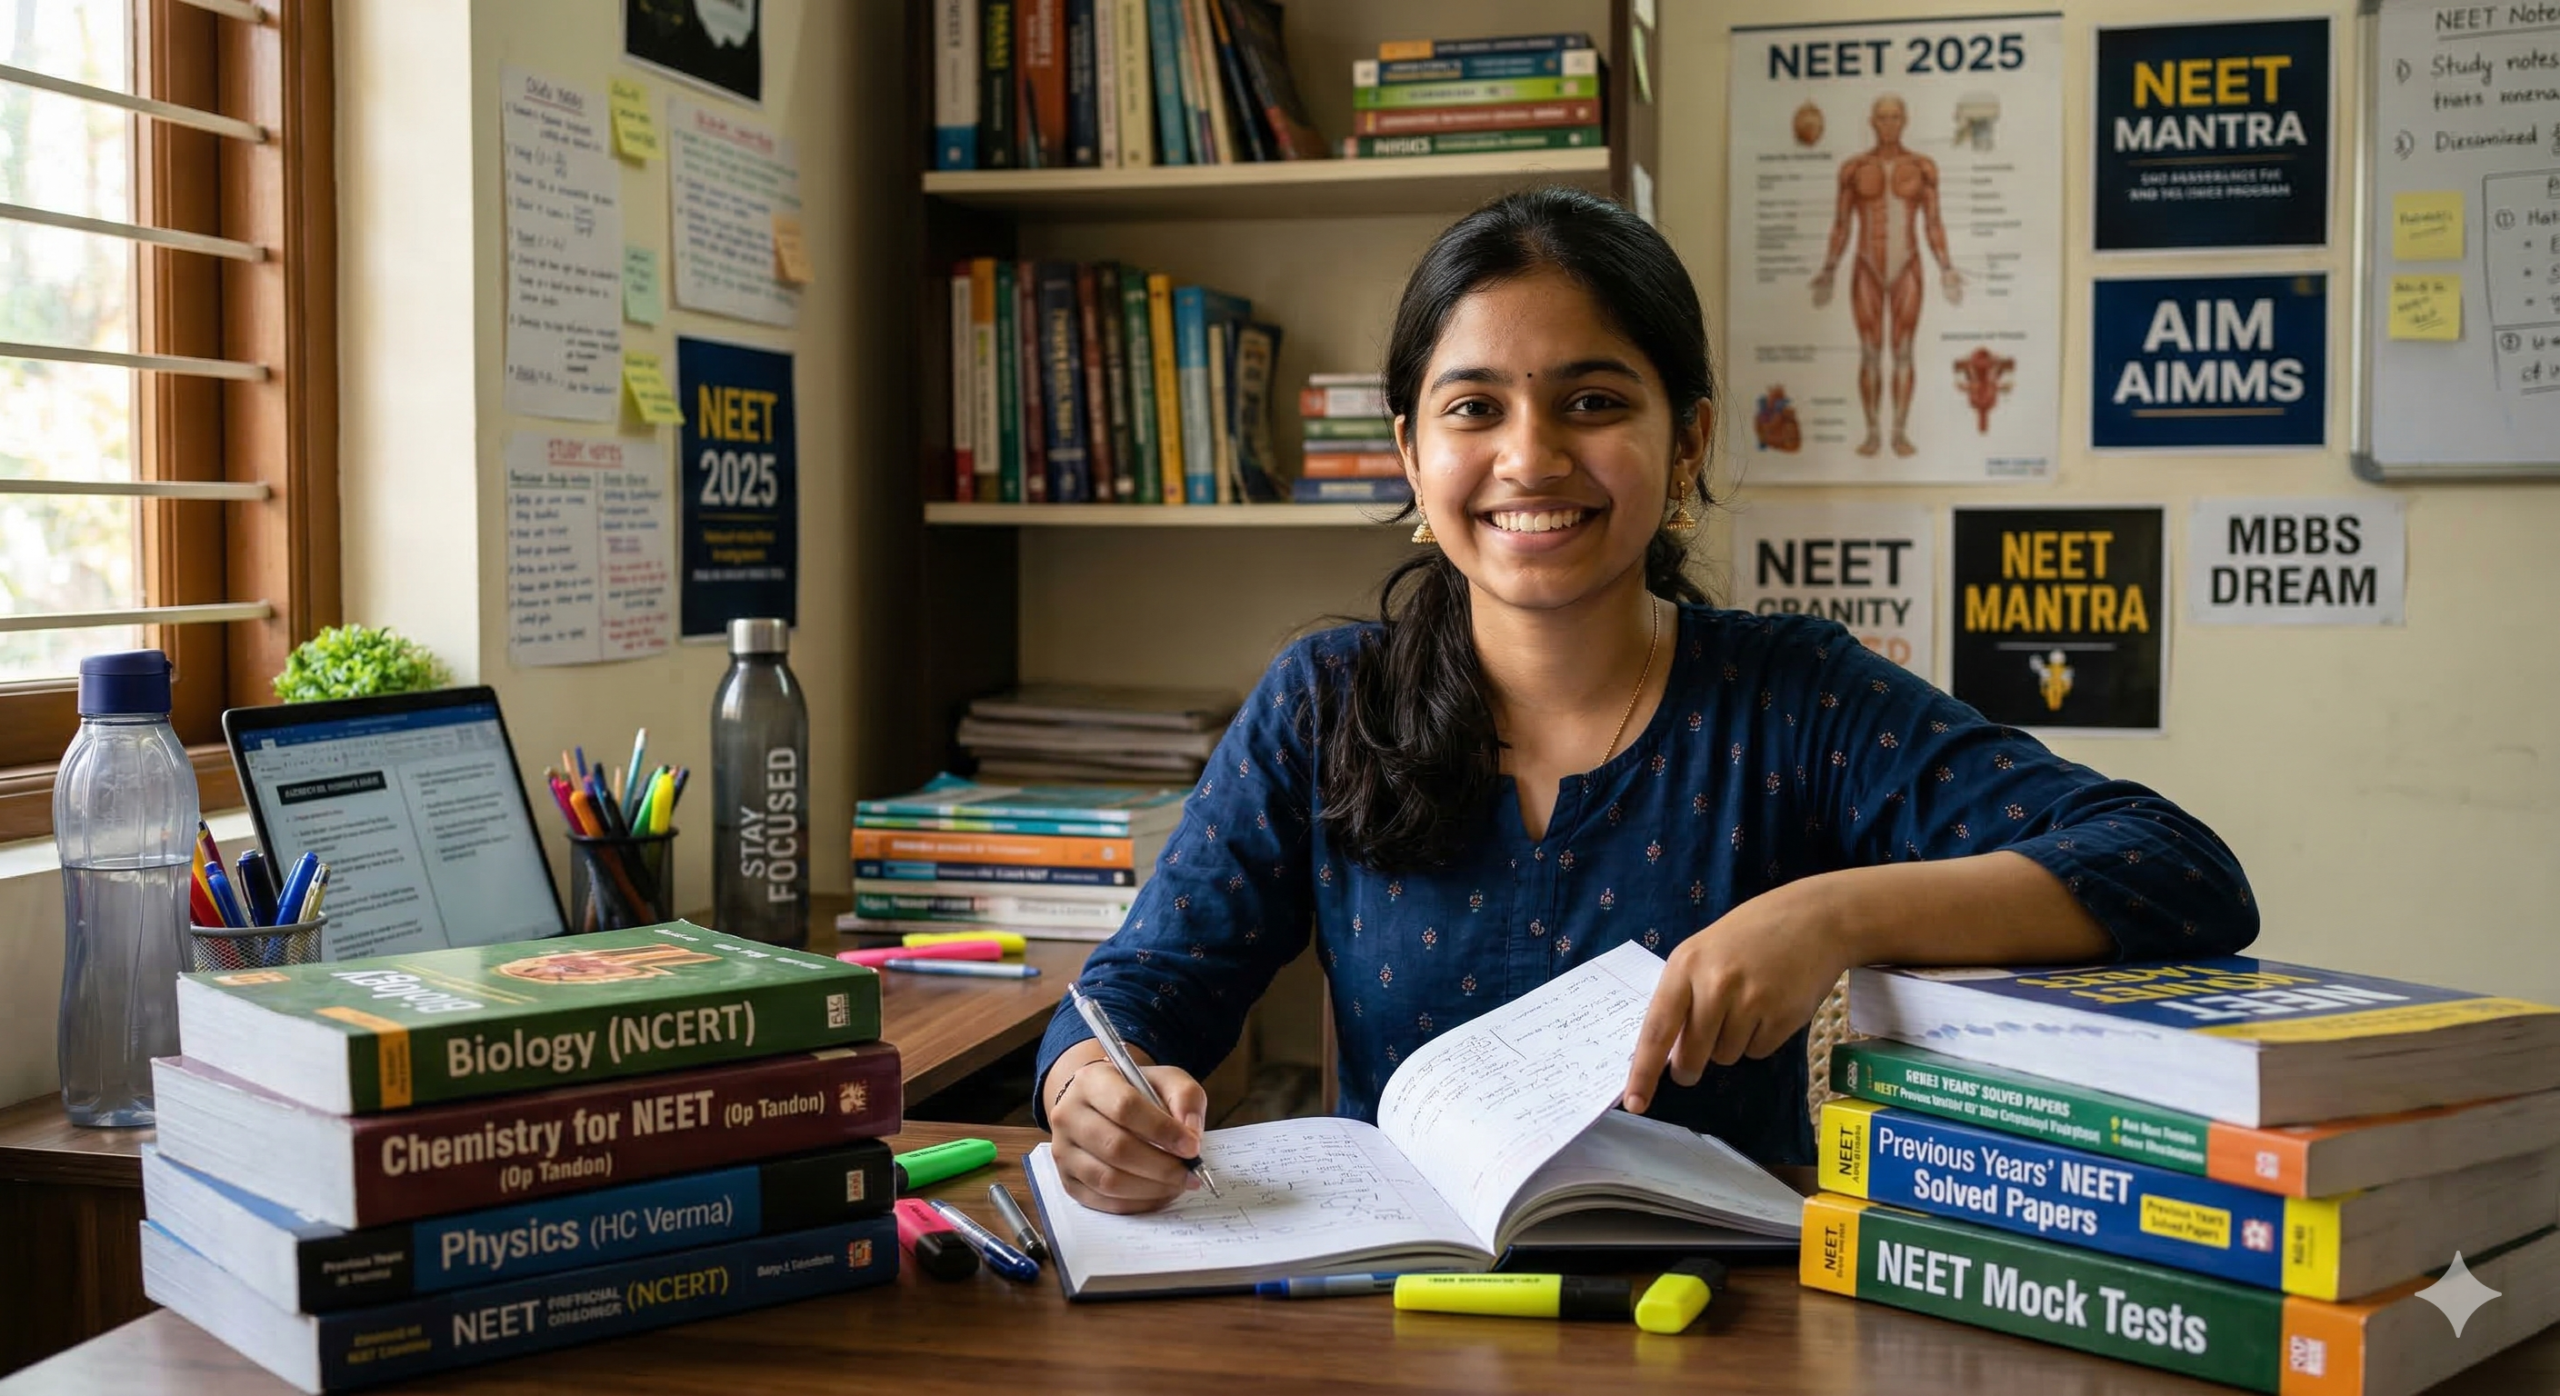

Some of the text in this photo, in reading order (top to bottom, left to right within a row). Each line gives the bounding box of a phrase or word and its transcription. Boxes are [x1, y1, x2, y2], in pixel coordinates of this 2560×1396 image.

[2435, 2, 2560, 31] NEET Note
[1768, 34, 2026, 80] NEET 2025
[2430, 51, 2493, 86] Study
[2507, 48, 2560, 72] notes
[2133, 55, 2293, 109] NEET
[2113, 110, 2308, 153] MANTRA
[2142, 298, 2274, 353] AIM
[2113, 357, 2305, 404] AIMMS
[698, 383, 778, 443] NEET
[700, 448, 778, 507] 2025
[2002, 531, 2114, 580] NEET
[2227, 515, 2362, 556] MBBS
[1757, 539, 1914, 588] NEET
[2211, 566, 2378, 606] DREAM
[1965, 583, 2149, 633] MANTRA
[740, 805, 766, 879] STAY
[767, 747, 798, 903] FOCUSED
[330, 970, 485, 1014] Biology
[2156, 985, 2411, 1021] NEET
[447, 1000, 756, 1078] Biology (NCERT)
[1981, 1086, 2024, 1107] SOLVED
[2025, 1094, 2071, 1118] PAPERS
[381, 1089, 826, 1177] Chemistry for NEET (Op Tandon)
[1838, 1127, 1855, 1176] NEET
[500, 1152, 613, 1193] (Op Tandon)
[1878, 1127, 2134, 1205] Previous Years' NEET
[1914, 1168, 2098, 1236] Solved Papers
[441, 1194, 733, 1271] Physics (HC Verma)
[1824, 1226, 1839, 1271] NEET
[453, 1300, 540, 1346] NEET
[627, 1266, 729, 1313] (NCERT)
[1876, 1239, 2207, 1355] NEET Mock Tests
